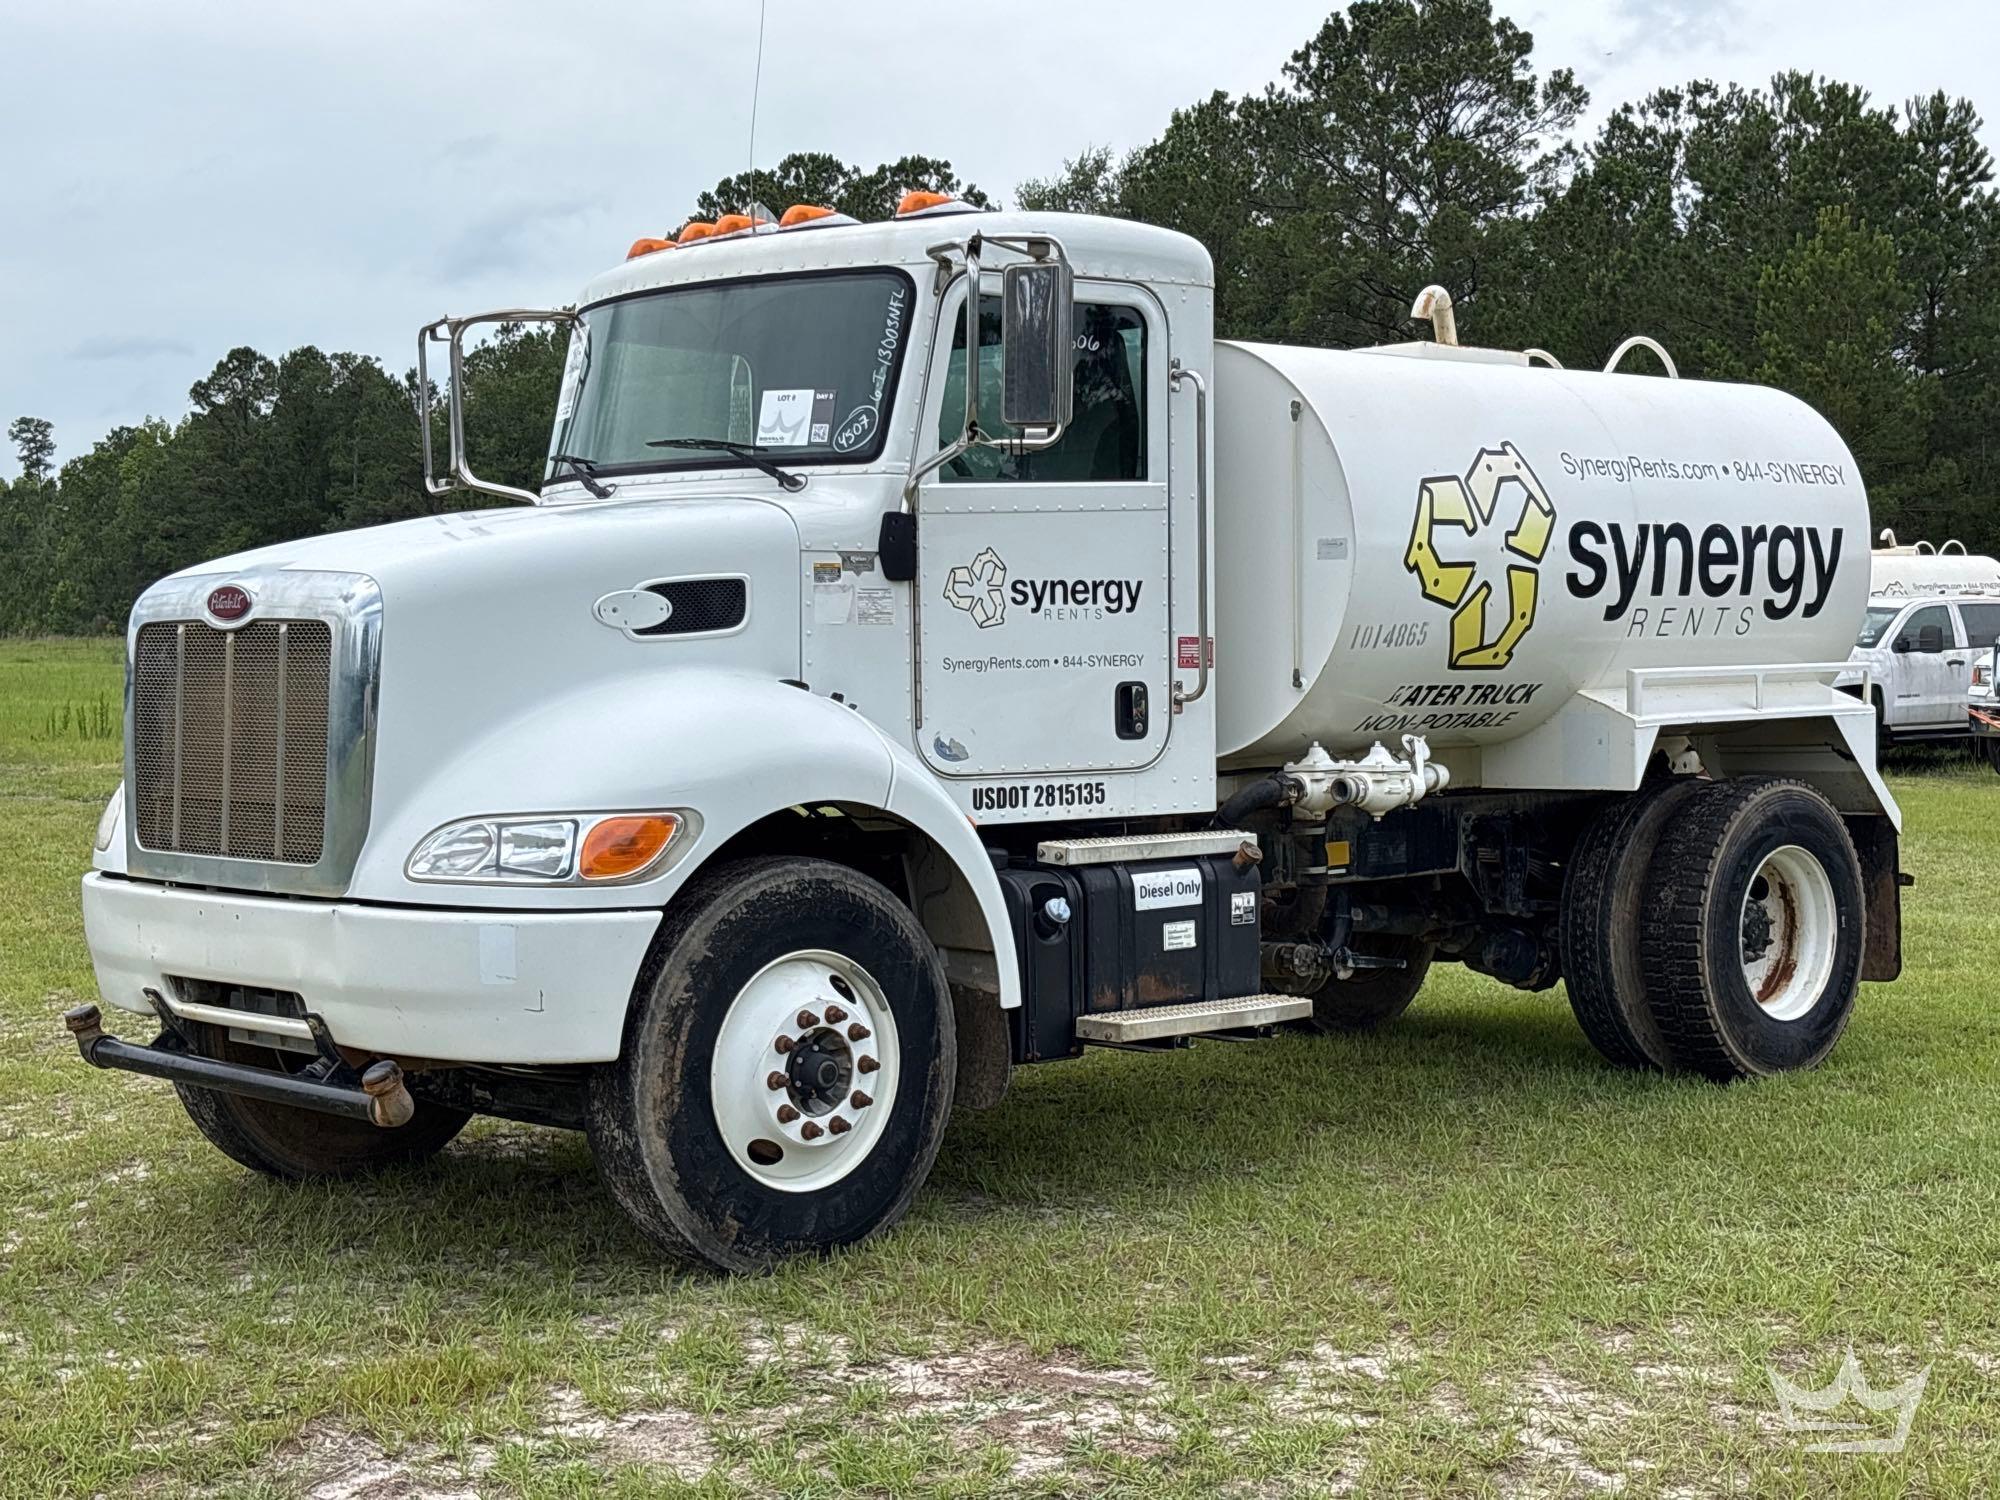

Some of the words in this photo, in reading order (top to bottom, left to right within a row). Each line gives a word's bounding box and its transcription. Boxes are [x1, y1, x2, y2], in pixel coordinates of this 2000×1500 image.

[1560, 452, 1719, 482] SynergyRents.com
[1733, 461, 1847, 486] 844-SYNERGY
[1566, 520, 1844, 621] synergy
[211, 592, 244, 610] Peterbilt
[1010, 578, 1144, 614] synergy
[1044, 609, 1103, 620] RENTS
[1627, 607, 1754, 637] RENTS
[1350, 622, 1430, 650] 1014865
[942, 658, 1050, 673] SynergyRents.com
[1063, 655, 1145, 668] 844-SYNERGY
[1463, 683, 1544, 705] TRUCK
[1354, 711, 1519, 732] NON-POTABLE
[972, 787, 1030, 810] USDOT
[1034, 782, 1106, 807] 2815135
[1140, 882, 1173, 899] Diesel
[1176, 880, 1201, 897] Only
